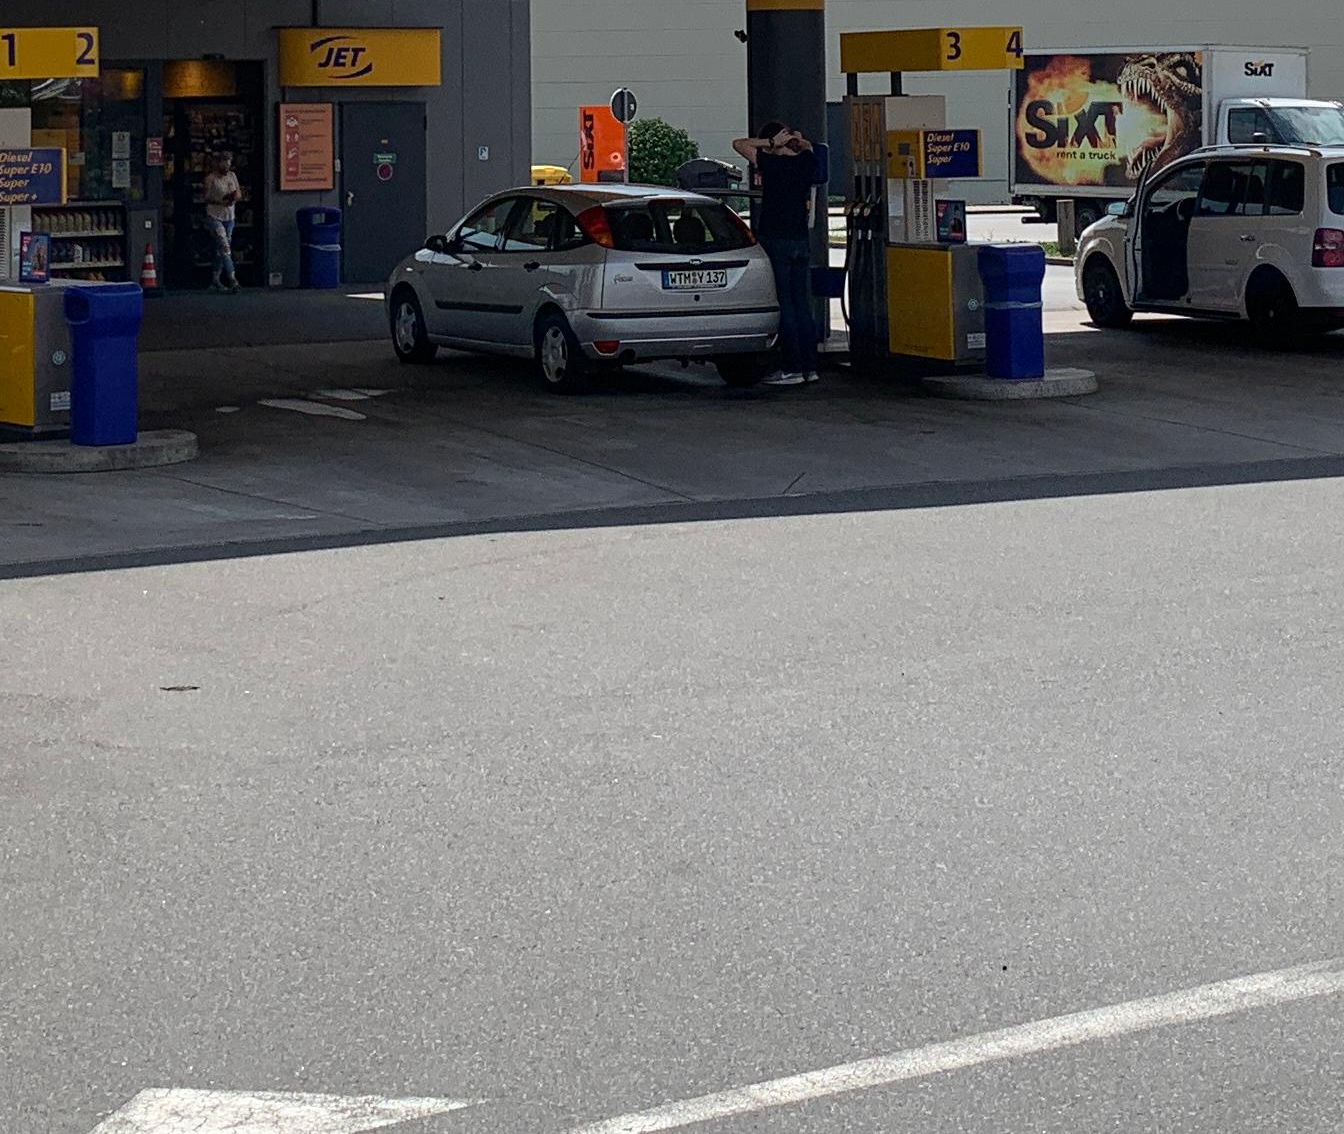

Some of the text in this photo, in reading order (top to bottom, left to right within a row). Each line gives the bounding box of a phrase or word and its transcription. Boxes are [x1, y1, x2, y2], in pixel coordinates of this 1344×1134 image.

[1, 33, 16, 66] 1
[76, 32, 96, 65] 2
[946, 32, 962, 60] 3
[1006, 31, 1023, 58] 4
[318, 47, 366, 68] JET
[927, 144, 952, 154] Super
[1056, 151, 1078, 160] rent
[1089, 150, 1116, 160] truck
[31, 163, 52, 174] E10
[927, 154, 953, 166] Super
